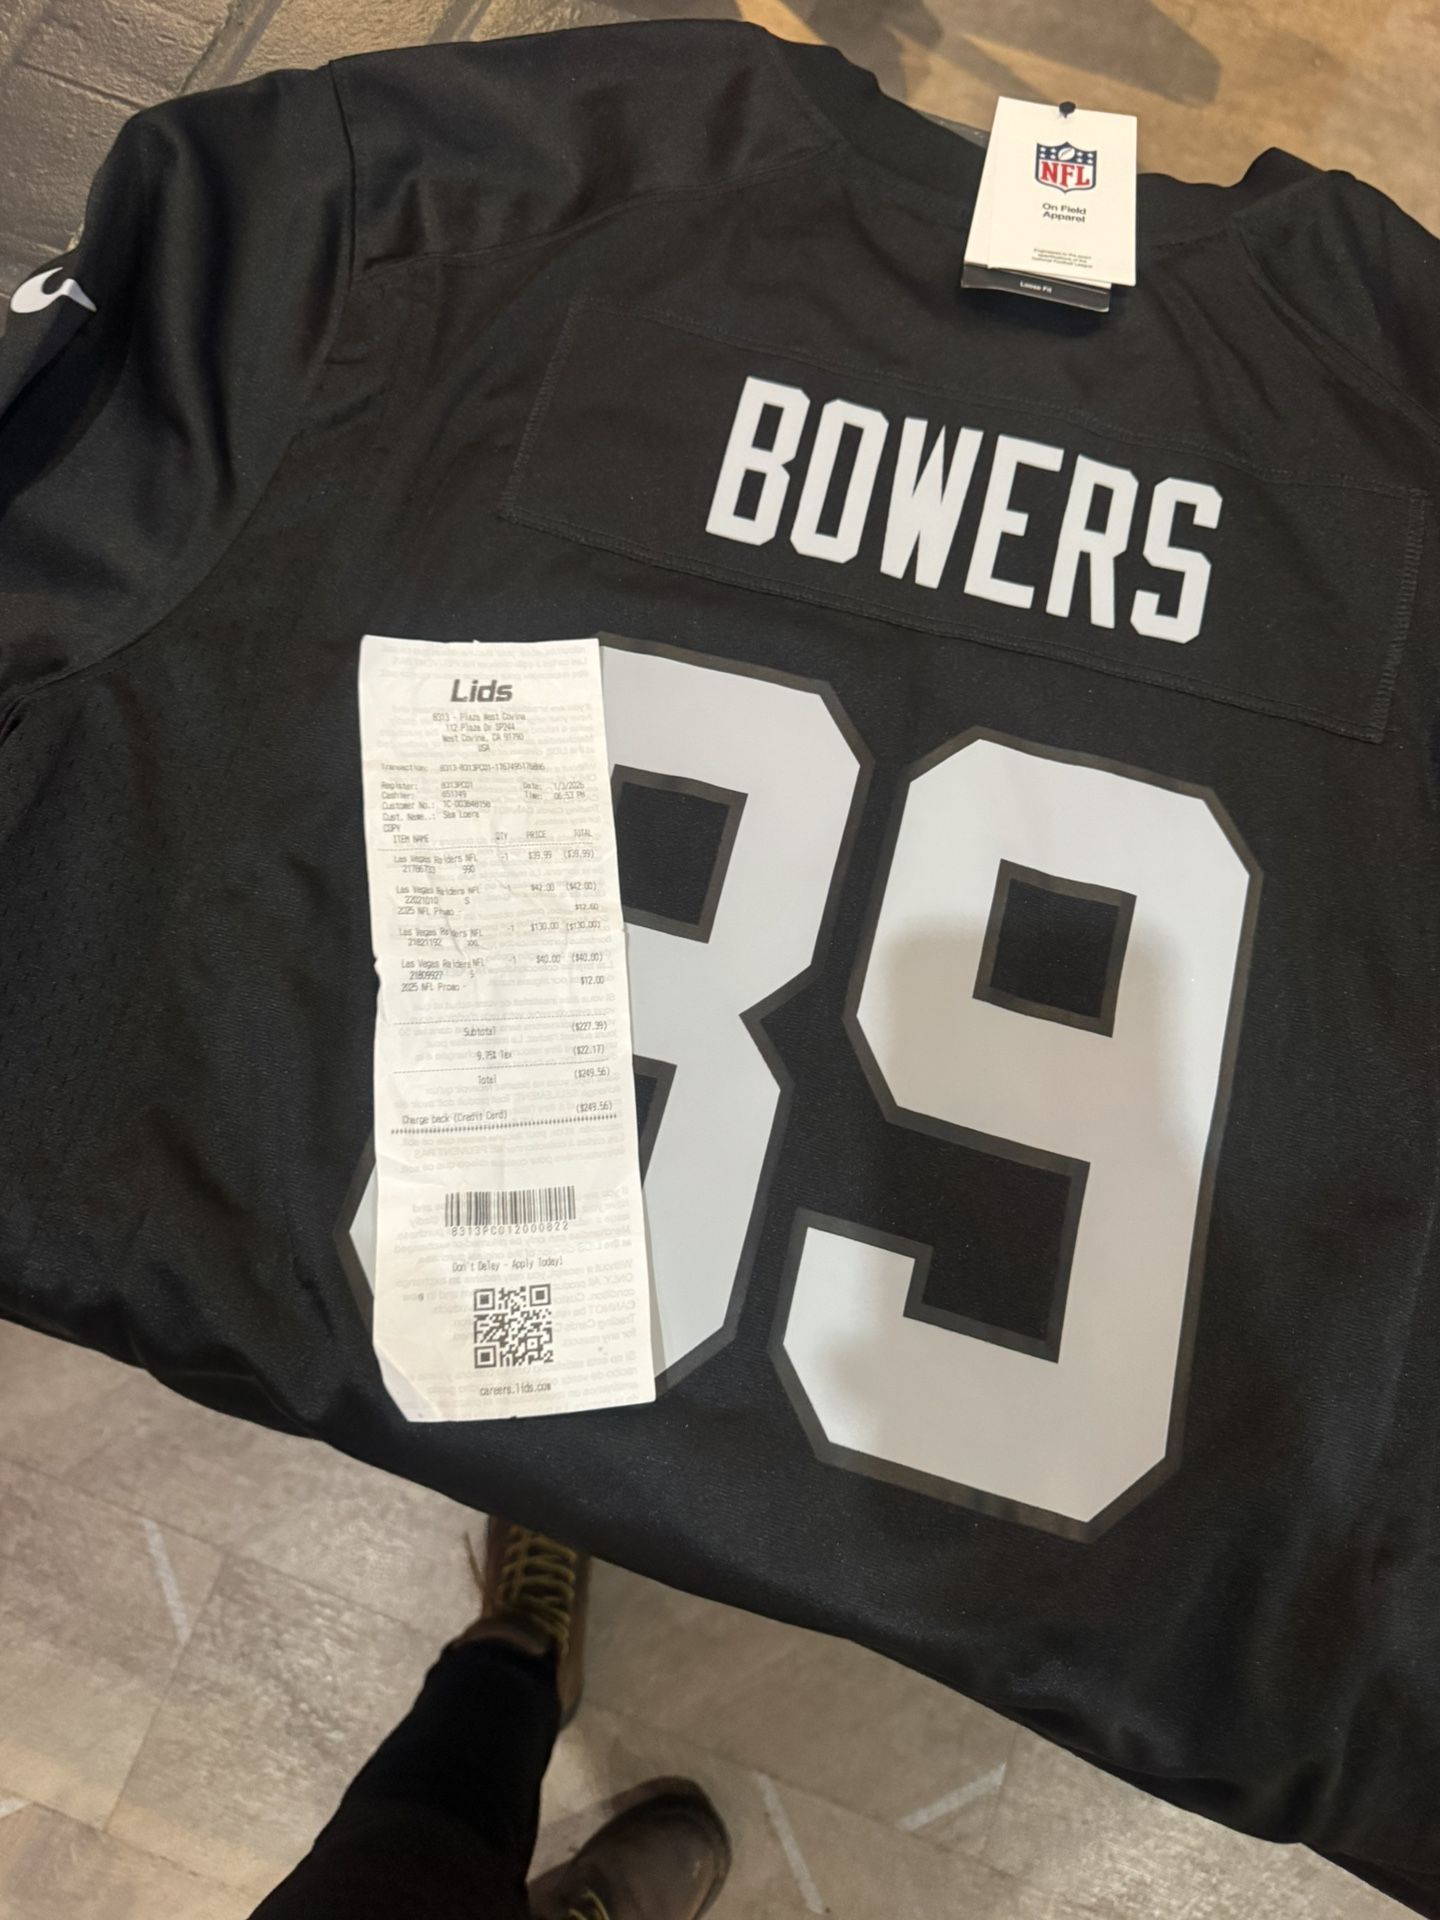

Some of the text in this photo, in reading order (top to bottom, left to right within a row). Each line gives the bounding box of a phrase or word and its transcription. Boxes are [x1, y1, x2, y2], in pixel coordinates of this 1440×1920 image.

[1040, 161, 1091, 188] NFL
[1042, 202, 1087, 215] On Field
[1042, 211, 1086, 223] Apparel
[705, 376, 1224, 645] BOWERS
[450, 678, 514, 703] Lids
[459, 712, 481, 722] Plaza
[484, 712, 500, 721] West
[501, 712, 526, 721] Covina
[460, 723, 481, 732] Plaza
[442, 734, 459, 743] West
[491, 733, 502, 742] CA
[523, 790, 543, 800] Time:
[576, 790, 586, 799] PM
[381, 801, 416, 810] Customer
[383, 823, 402, 833] COPY
[393, 834, 411, 844] ITEM
[495, 831, 509, 841] QTY
[526, 830, 547, 839] PRICE
[573, 828, 593, 838] TOTAL
[393, 855, 408, 863] Las
[410, 855, 432, 864] Vegas
[433, 855, 464, 864] Raiders
[464, 852, 479, 862] NFL
[528, 850, 553, 860] $39.99
[563, 848, 595, 860] ($39.99)
[395, 885, 410, 894] Las
[412, 886, 435, 895] Vegas
[436, 886, 466, 896] Raiders
[467, 885, 481, 894] NFL
[530, 882, 556, 892] $42.00
[565, 880, 597, 892] ($42.00)
[464, 896, 471, 905] S
[397, 905, 415, 915] 2025
[417, 906, 431, 916] NFL
[399, 927, 413, 937] Las
[415, 927, 438, 938] Vegas
[469, 928, 484, 938] NFL
[530, 921, 560, 932] $130.00
[566, 920, 602, 932] ($130.00)
[401, 960, 416, 969] Las
[417, 959, 441, 970] Vegas
[442, 958, 472, 969] Raiders
[472, 957, 485, 967] NFL
[536, 954, 562, 964] $40.00
[571, 952, 604, 963] ($40.00)
[400, 982, 420, 993] 2025
[421, 982, 435, 992] NFL
[437, 982, 461, 992] Promo
[580, 975, 605, 985] $12.00
[463, 1020, 608, 1037] Subtotal ($227.39)
[500, 1049, 513, 1060] Tax
[572, 1044, 606, 1057] ($22.17)
[478, 1066, 611, 1085] Total ($249.56)
[401, 1100, 614, 1126] Charge back (Credit Card) ($249.56)
[451, 1220, 570, 1237] 8313PC012000822
[451, 1260, 476, 1273] Don't
[477, 1258, 501, 1272] Delay
[511, 1257, 534, 1270] Apply
[537, 1254, 564, 1267] Today!
[479, 1381, 552, 1396] careers.lids.com
